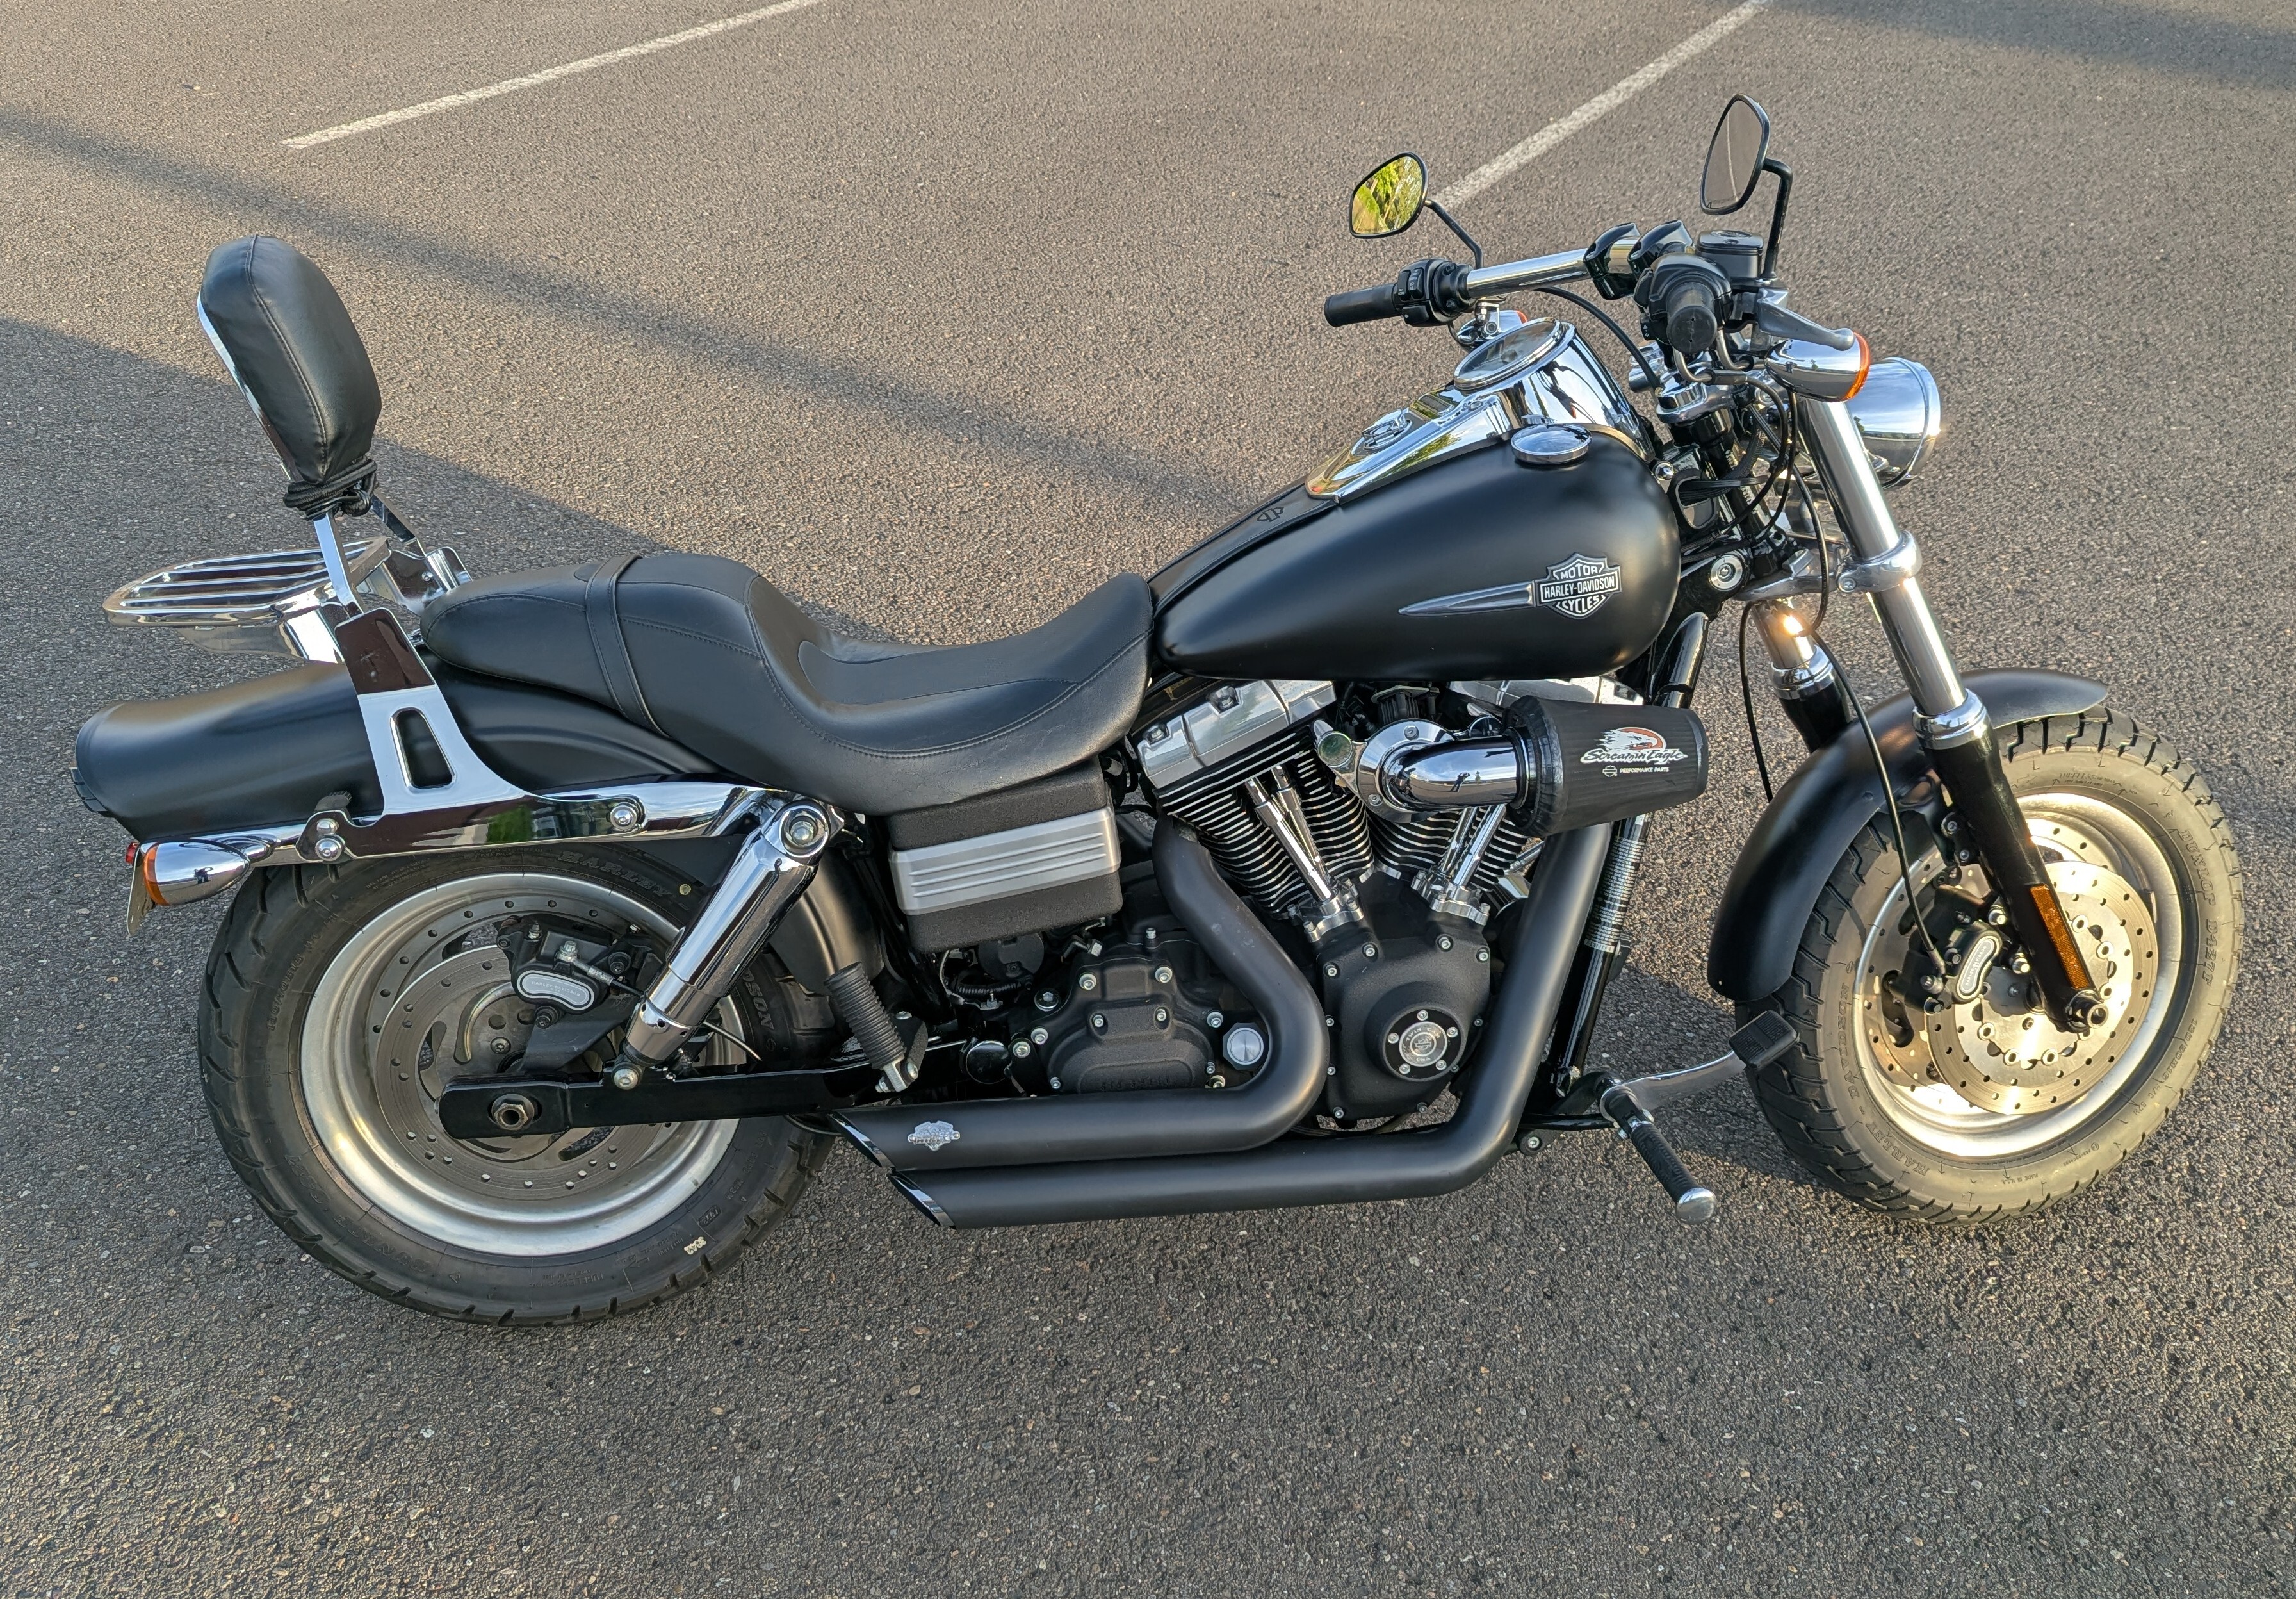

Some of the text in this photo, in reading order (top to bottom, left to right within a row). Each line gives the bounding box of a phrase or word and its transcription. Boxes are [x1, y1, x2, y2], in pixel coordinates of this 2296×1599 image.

[1560, 563, 1598, 580] MOTOR
[1544, 576, 1615, 598] HARLEY-DAVIDSON
[1562, 594, 1600, 613] CYCLES
[1646, 749, 1686, 764] Eagle
[557, 851, 673, 897] HARLEY
[2178, 829, 2217, 906] DUNLOP
[2202, 918, 2219, 987] D427F
[1966, 946, 1987, 986] HARLEY-DAVIDSON
[532, 981, 581, 997] HARLEY-DAVIDSON
[1405, 1028, 1422, 1042] TWIN
[1837, 983, 1860, 1099] DAVIDSON
[1865, 1121, 1930, 1177] HARLEY
